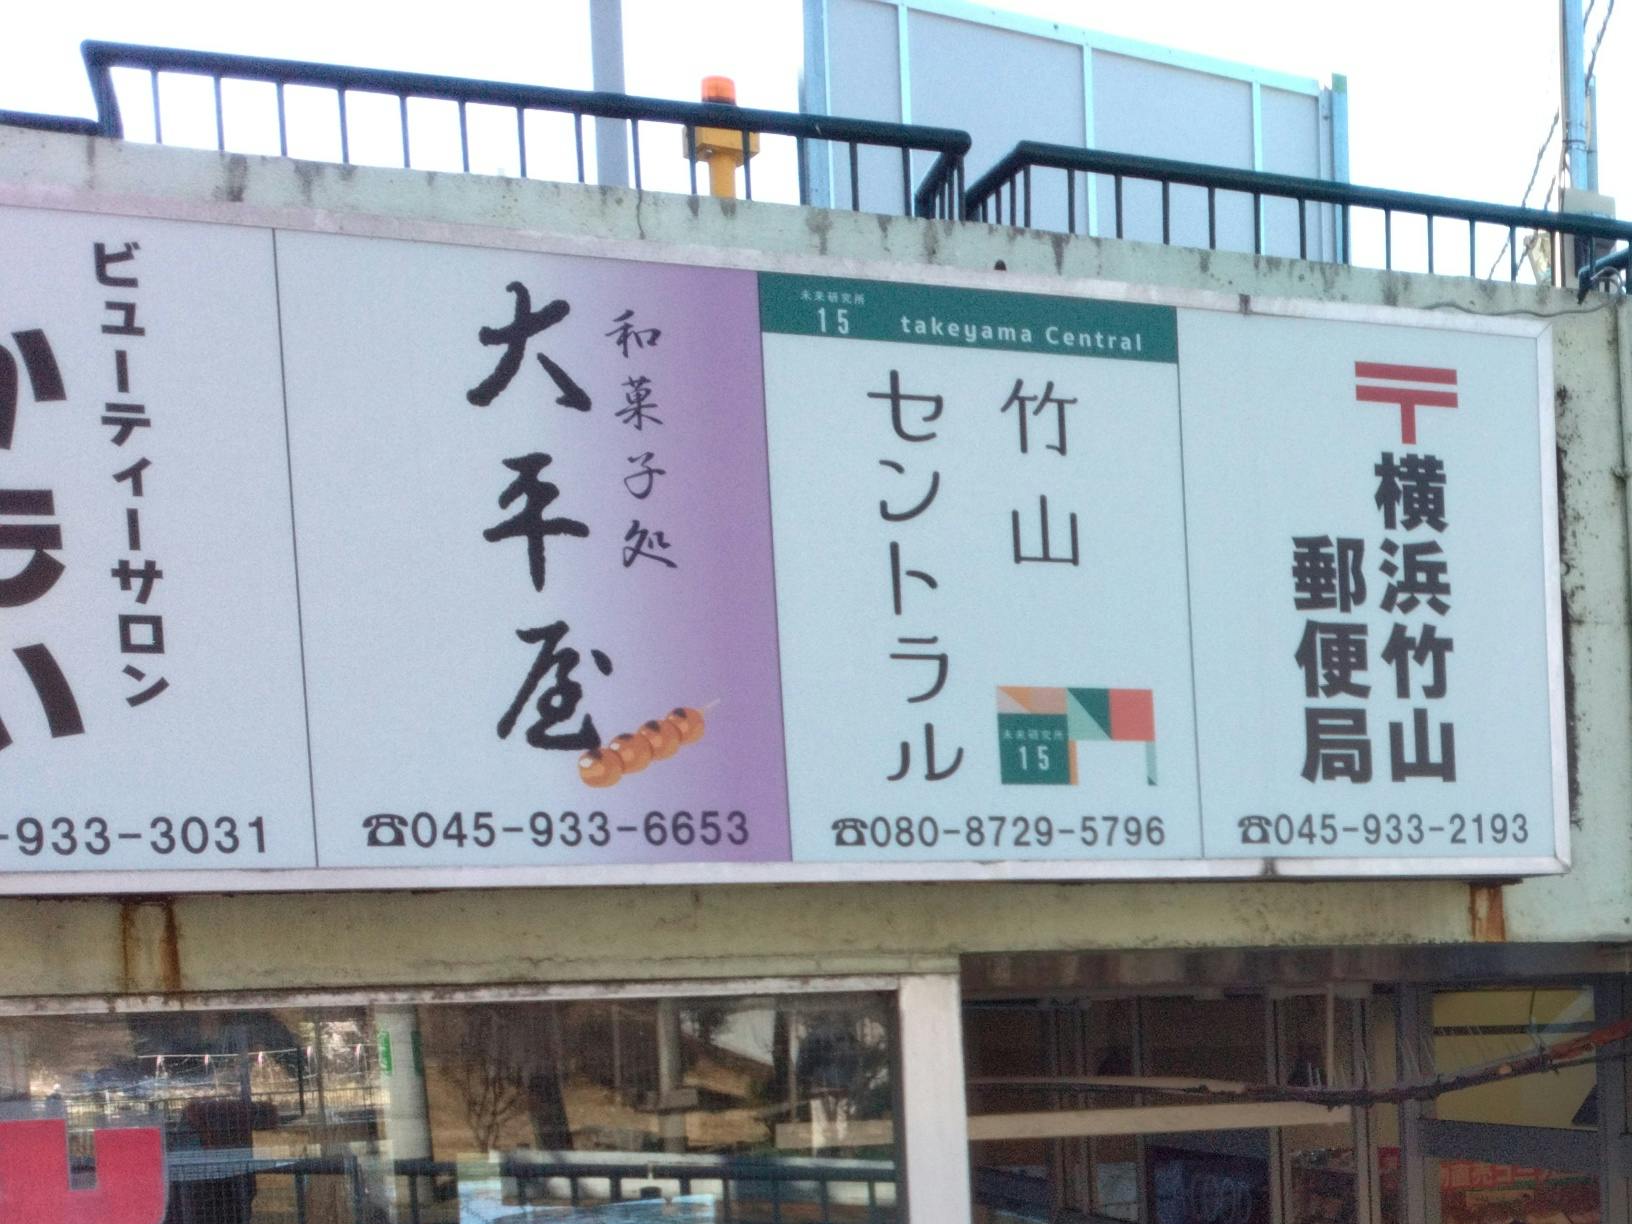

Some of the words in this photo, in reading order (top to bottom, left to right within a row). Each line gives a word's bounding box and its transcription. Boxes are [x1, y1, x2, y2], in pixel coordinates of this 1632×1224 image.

[605, 309, 678, 569] 和菓子処
[818, 307, 849, 334] 15
[900, 314, 1034, 347] takeyama
[1045, 324, 1143, 352] Central
[92, 241, 170, 707] ビューティーサロン
[467, 281, 613, 750] 大平屋
[867, 369, 965, 783] セントラル
[1001, 377, 1080, 568] 竹山
[1291, 535, 1373, 785] 郵便局
[1375, 452, 1458, 784] 横浜竹山
[1018, 745, 1049, 771] 15
